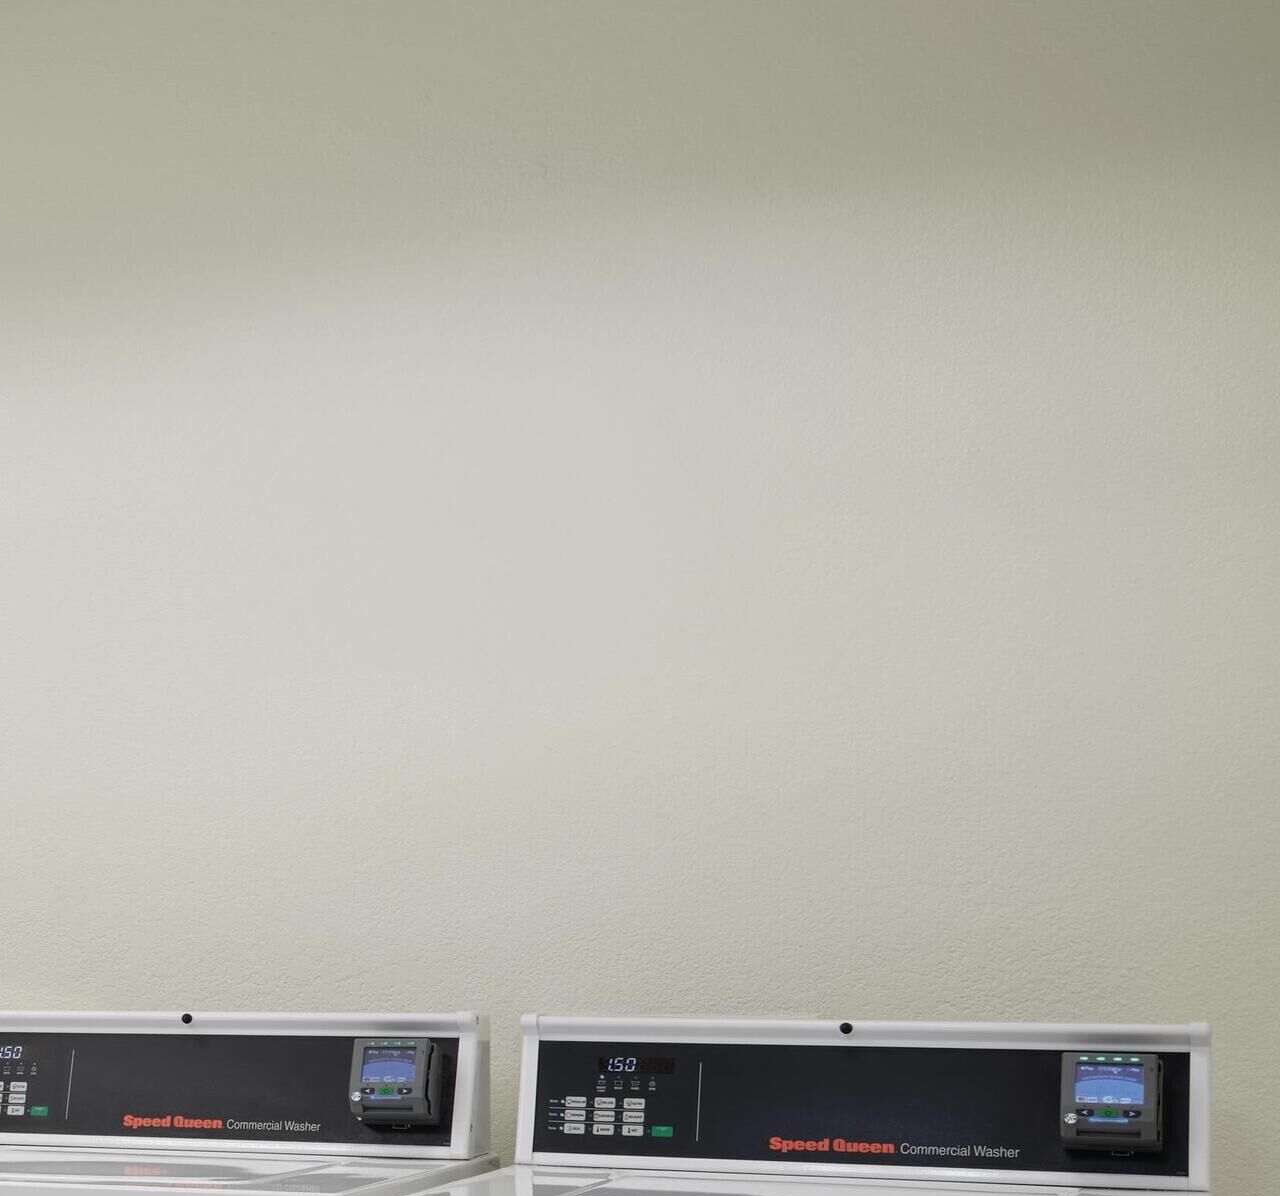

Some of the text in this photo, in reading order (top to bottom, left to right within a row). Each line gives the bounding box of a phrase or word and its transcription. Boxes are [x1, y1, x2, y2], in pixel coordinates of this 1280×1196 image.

[0, 1046, 22, 1058] 1.50
[608, 1057, 636, 1071] 1.50
[123, 1114, 321, 1132] Speed Queen Commercial Washer
[768, 1136, 1020, 1158] Speed Queen Commercial Washer
